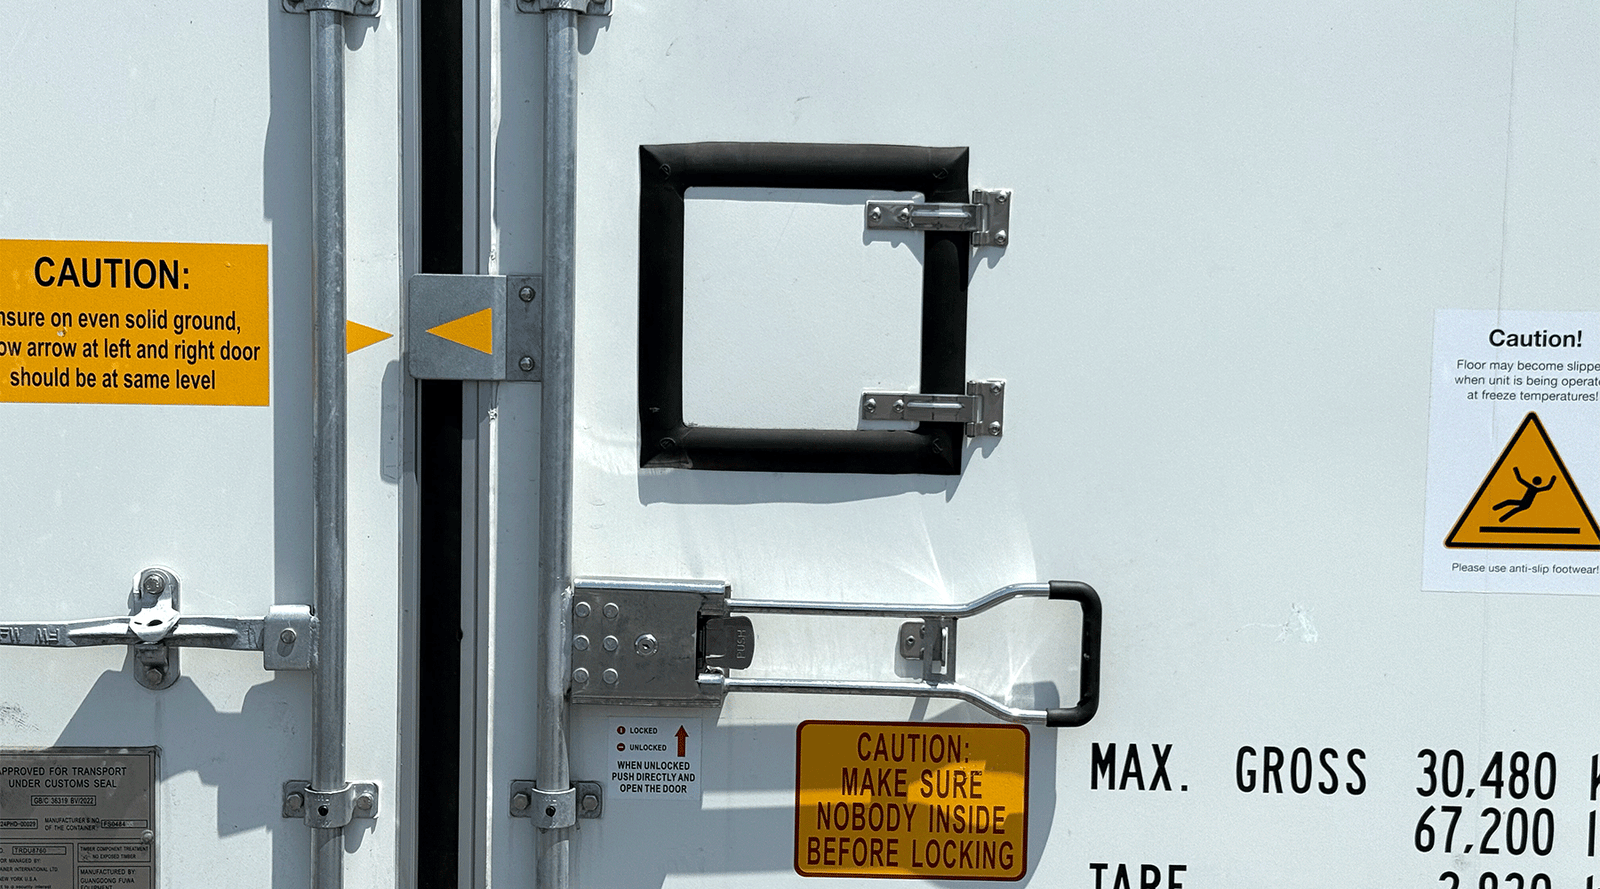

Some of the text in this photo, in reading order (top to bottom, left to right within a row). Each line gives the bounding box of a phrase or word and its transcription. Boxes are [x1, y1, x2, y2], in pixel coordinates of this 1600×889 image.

[34, 256, 190, 290] CAUTION:
[51, 312, 72, 328] on
[78, 312, 119, 328] even
[126, 310, 167, 329] solid
[173, 310, 241, 335] ground,
[1488, 328, 1583, 348] Caution!
[28, 341, 77, 358] arrow
[82, 342, 99, 358] at
[104, 338, 131, 359] left
[137, 340, 168, 360] and
[174, 340, 215, 365] right
[220, 341, 261, 361] door
[1457, 360, 1486, 370] Floor
[1490, 361, 1514, 373] may
[1517, 360, 1564, 372] become
[10, 367, 215, 389] should be at same level
[1455, 375, 1485, 385] when
[1488, 375, 1510, 386] unit
[1514, 376, 1523, 386] is
[1526, 376, 1558, 389] being
[1467, 390, 1599, 403] at freeze temperatures!
[1452, 563, 1599, 575] Please use anti-slip footwear!
[736, 629, 747, 659] PUSH
[857, 732, 969, 763] CAUTION:
[50, 767, 68, 776] FOR
[72, 767, 127, 776] TRANSPORT
[618, 761, 690, 770] WHEN UNLOCKED
[1091, 742, 1190, 792] MAX.
[1236, 745, 1368, 796] GROSS
[1416, 748, 1557, 800] 30,480
[8, 779, 117, 788] UNDER CUSTOMS SEAL
[612, 772, 696, 782] PUSH DIRECTLY AND
[842, 767, 983, 799] MAKE SURE
[620, 784, 687, 793] OPEN THE DOOR
[817, 802, 1006, 835] NOBODY INSIDE
[1414, 806, 1555, 857] 67,200
[807, 836, 1014, 870] BEFORE LOCKING
